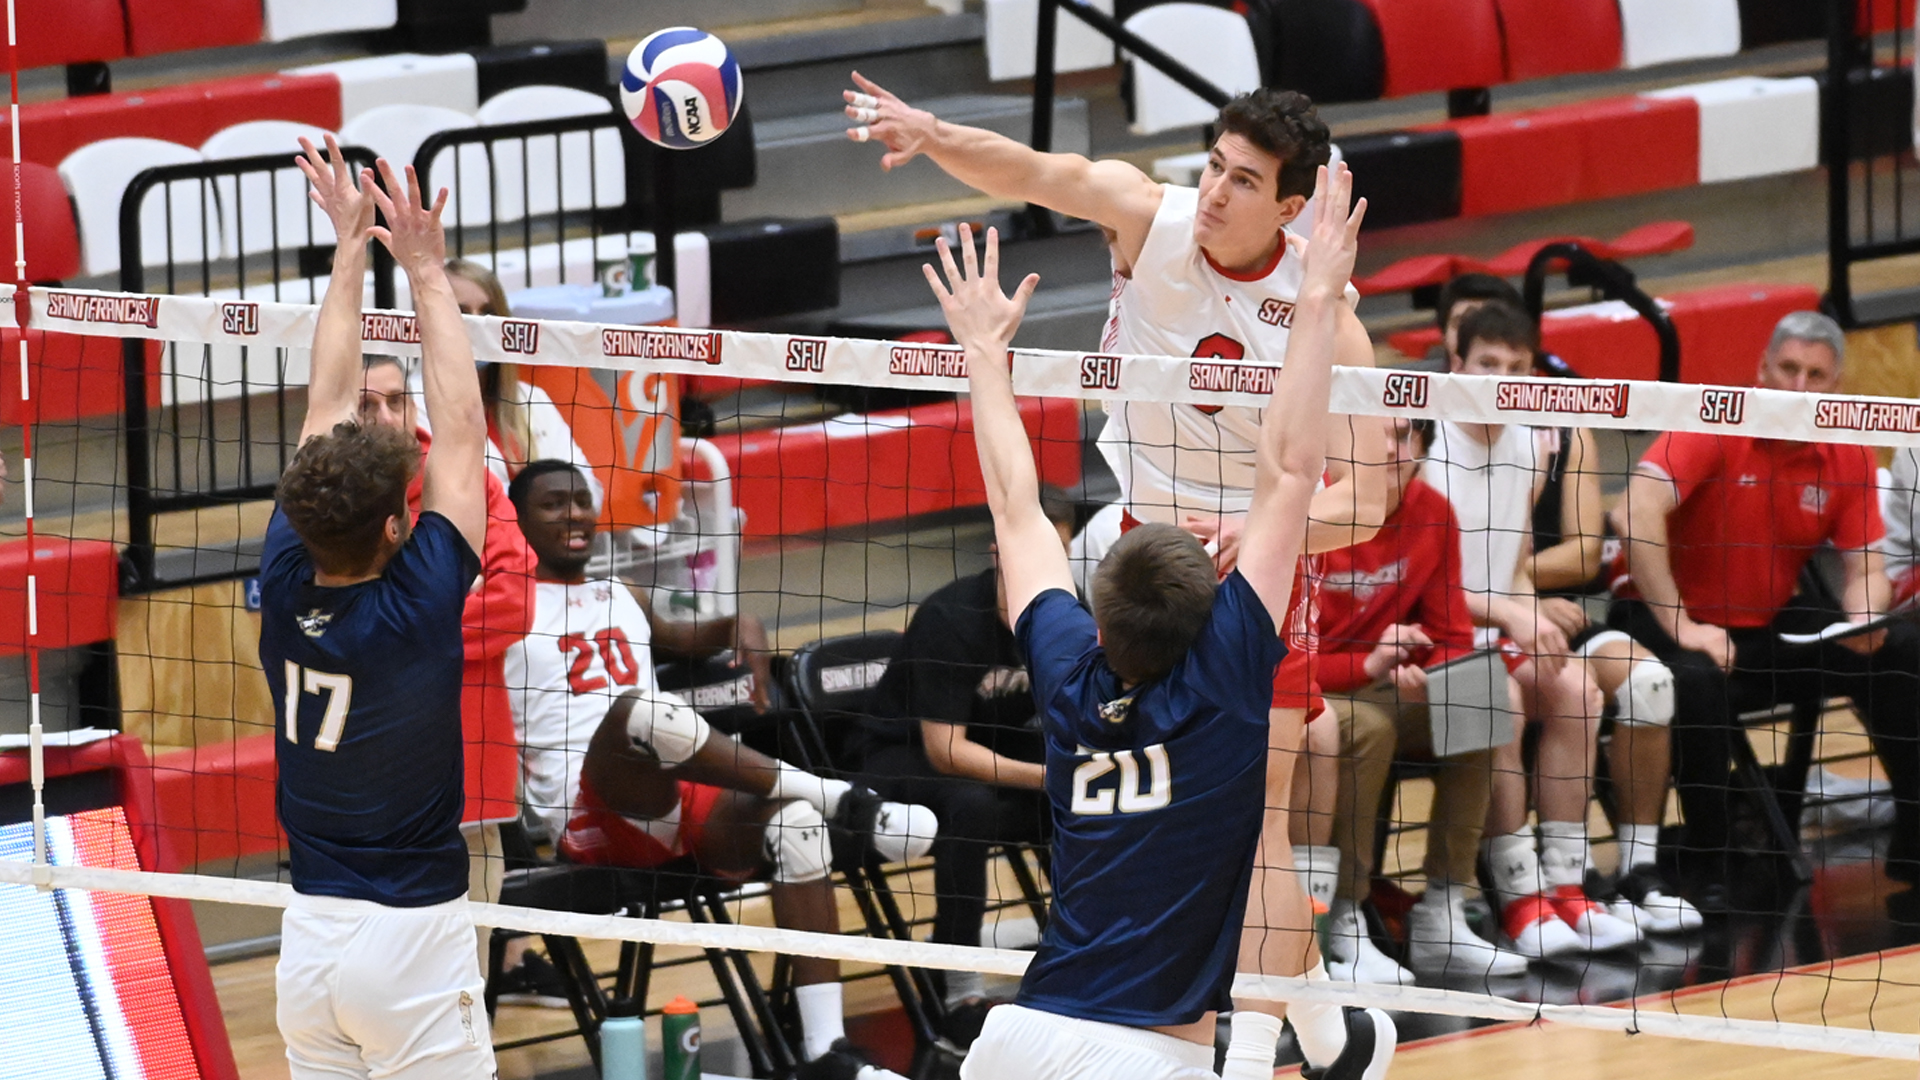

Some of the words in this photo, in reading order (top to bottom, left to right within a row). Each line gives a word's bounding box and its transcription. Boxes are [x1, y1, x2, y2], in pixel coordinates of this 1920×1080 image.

[684, 96, 701, 135] NCAA
[48, 292, 87, 321] SAINT
[223, 303, 258, 335] SFU
[502, 320, 540, 355] SFU
[602, 329, 645, 357] SAINT
[786, 338, 826, 372] SFU
[890, 347, 935, 376] SAINT
[1081, 356, 1123, 390] SFU
[1189, 362, 1235, 391] SAINT
[1235, 365, 1281, 395] FRAN
[1383, 373, 1429, 408] SFU
[1497, 382, 1545, 411] SAINT
[1700, 390, 1745, 425] SFU
[1815, 400, 1866, 430] SAINT
[1865, 402, 1920, 433] FRANC
[558, 627, 639, 697] 20
[284, 658, 353, 753] 17
[1070, 742, 1172, 815] 20
